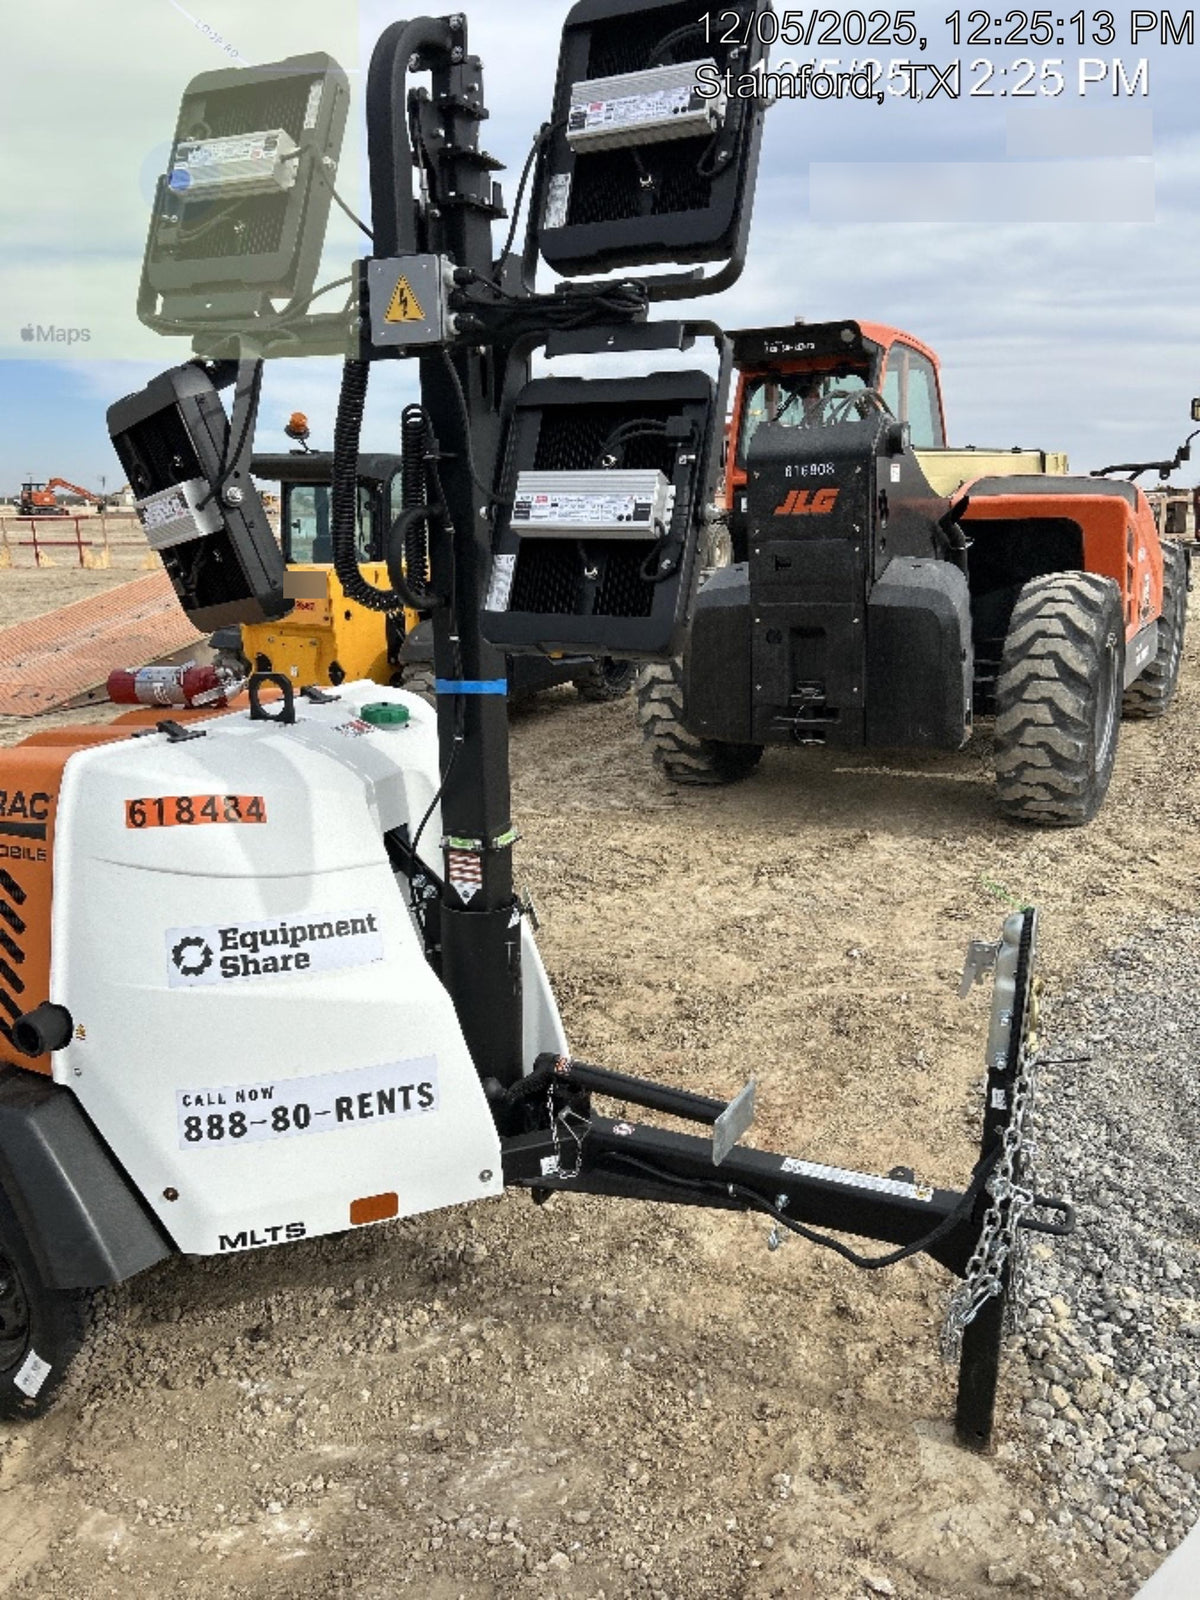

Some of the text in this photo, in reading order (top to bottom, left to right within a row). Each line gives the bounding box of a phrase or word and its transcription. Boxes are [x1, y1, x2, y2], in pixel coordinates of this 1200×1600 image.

[773, 488, 840, 515] JLG
[129, 796, 264, 828] 618484
[218, 913, 379, 953] Equipment
[219, 952, 311, 978] Share
[182, 1086, 275, 1107] CALL NOW
[184, 1082, 436, 1142] 888-80-RENTS
[218, 1221, 306, 1251] MLTS
